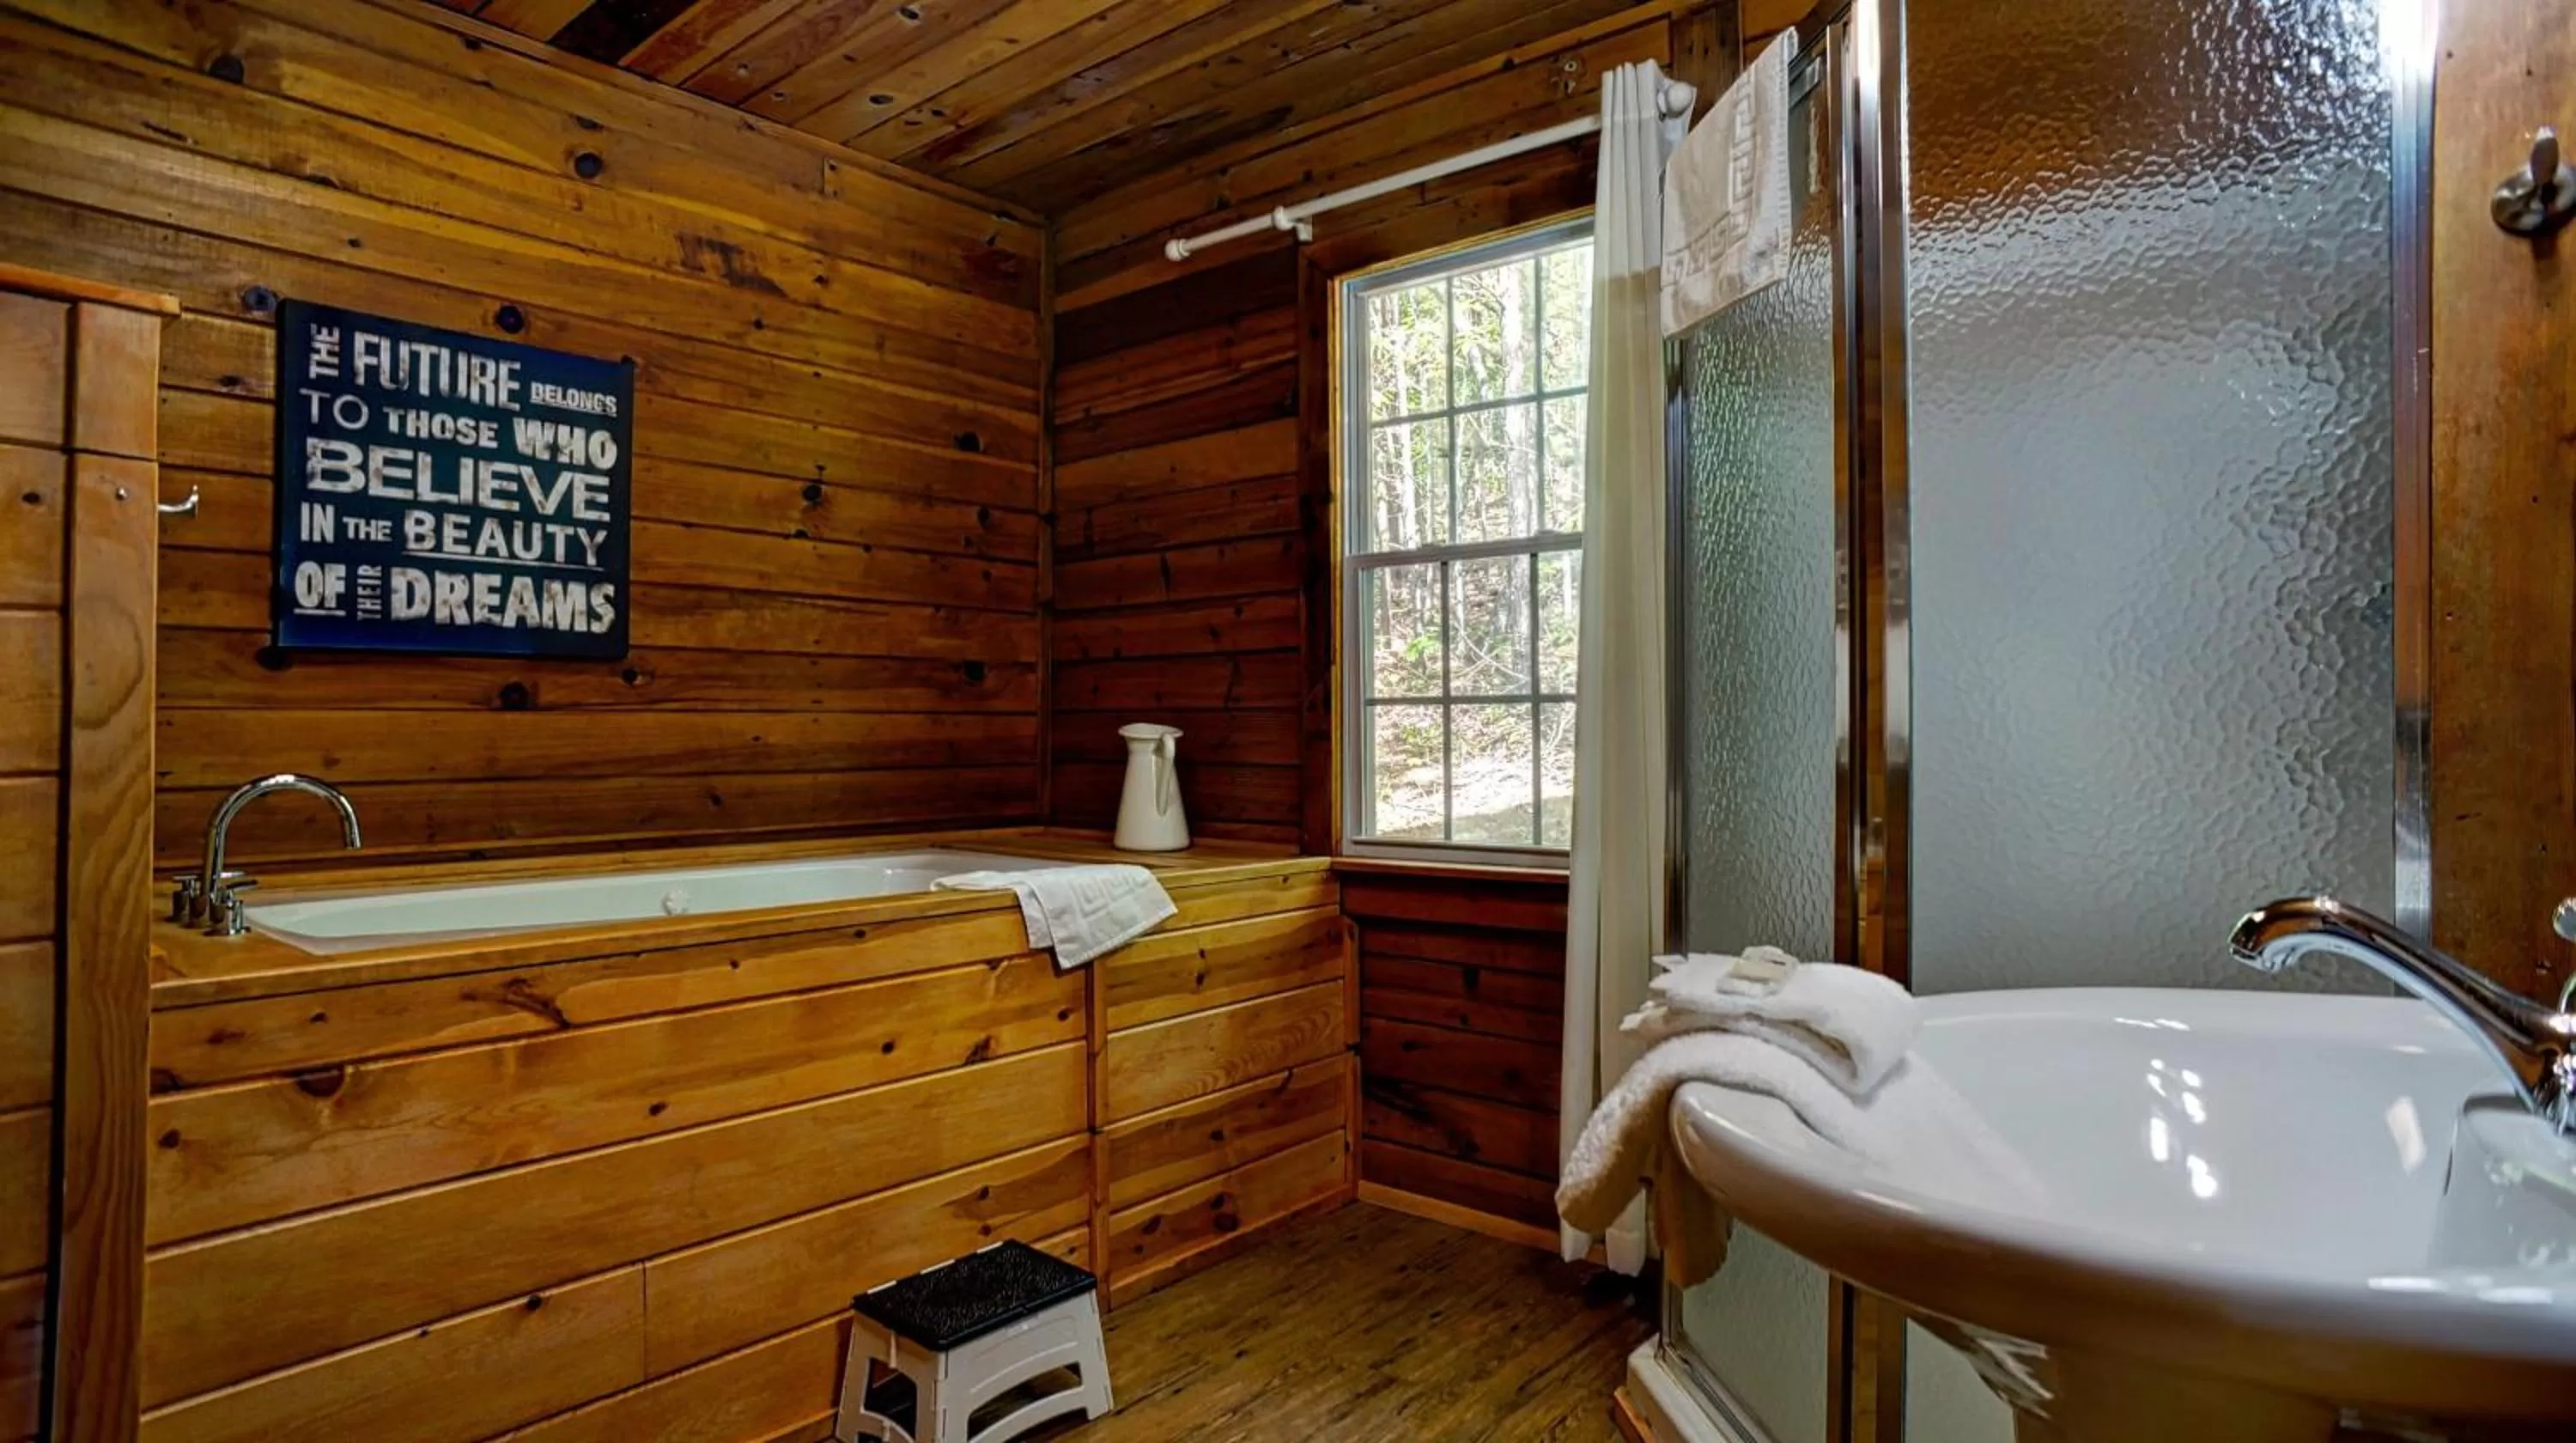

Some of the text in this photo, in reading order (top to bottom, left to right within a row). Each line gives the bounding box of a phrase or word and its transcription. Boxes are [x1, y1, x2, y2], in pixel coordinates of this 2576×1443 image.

[309, 323, 617, 413] THE FUTURE BELONGS
[300, 388, 618, 470] TO THOSE WHO
[306, 437, 611, 522] BELIEVE
[301, 502, 608, 566] IN THE BEAUTY
[295, 560, 617, 634] OF THEIR DREAMS
